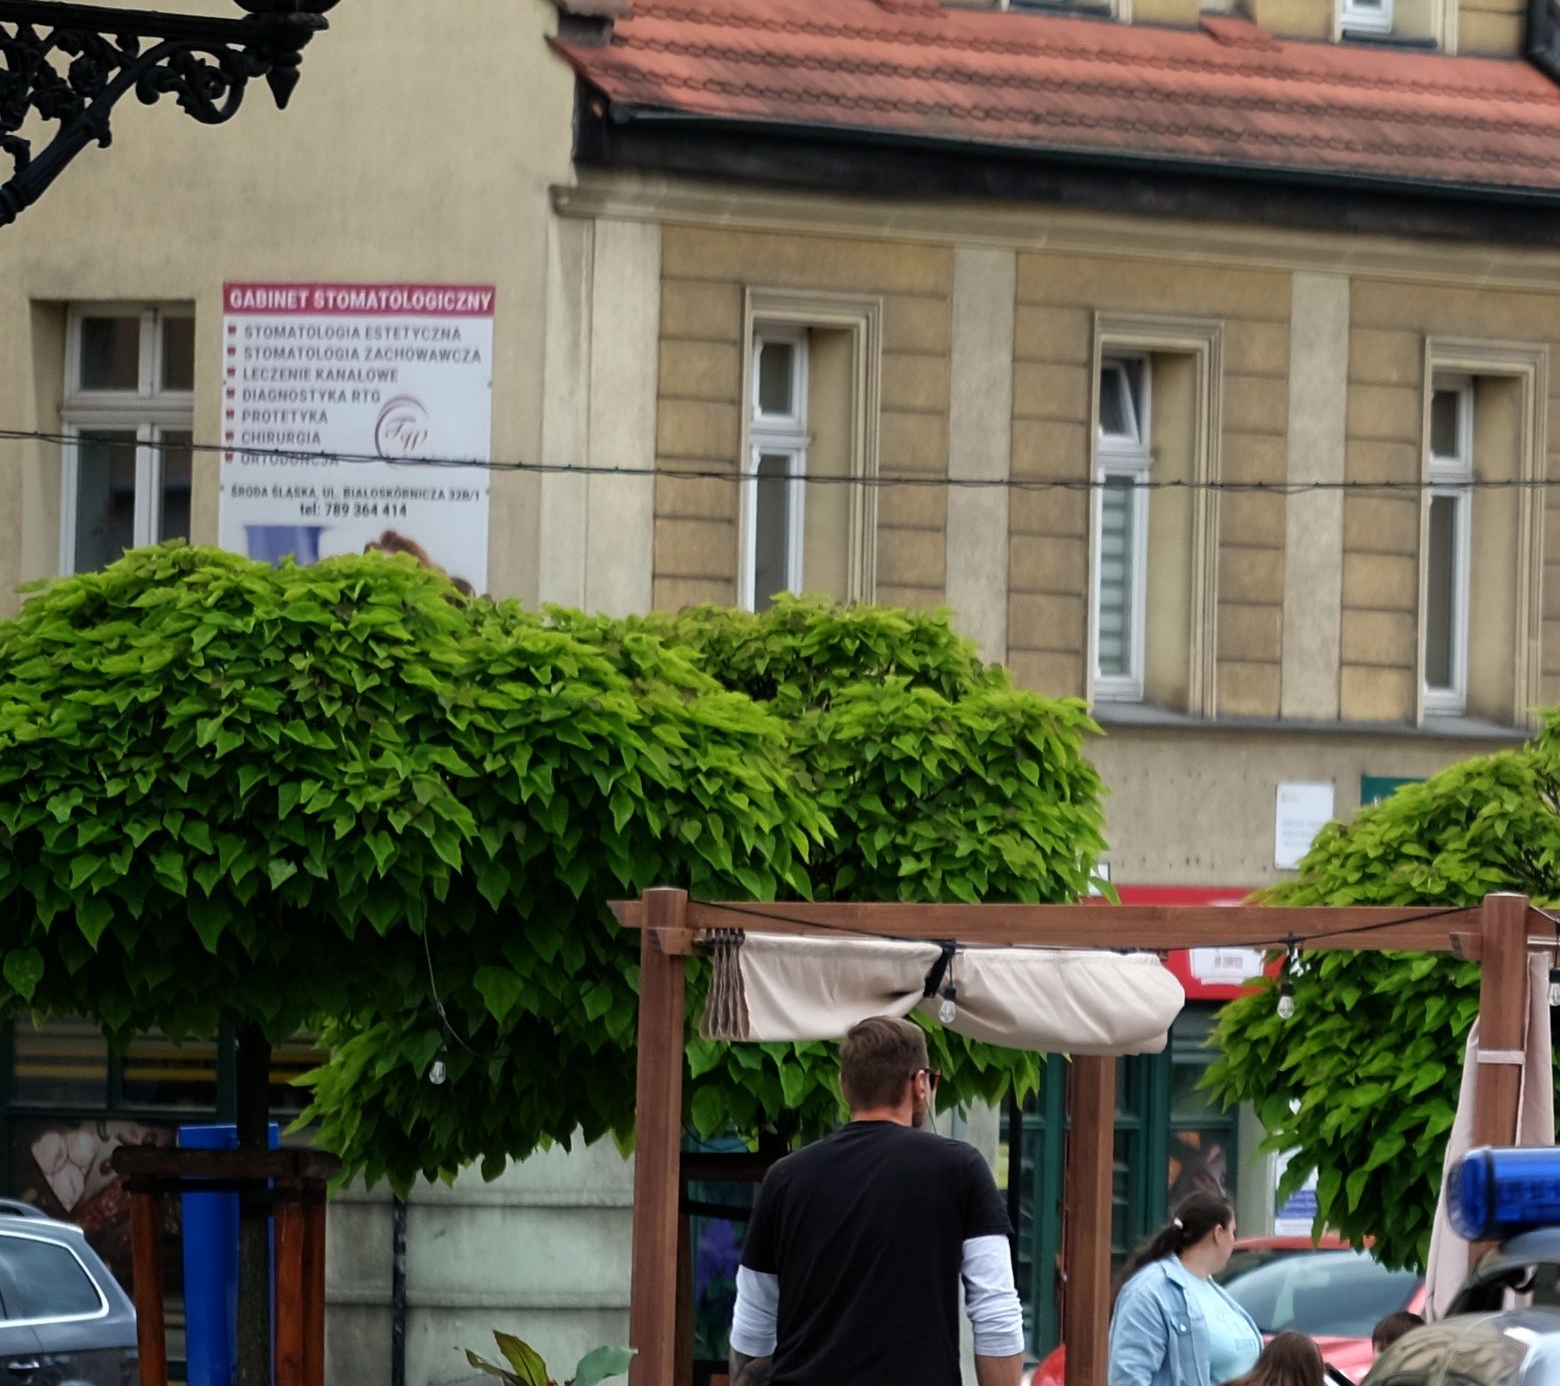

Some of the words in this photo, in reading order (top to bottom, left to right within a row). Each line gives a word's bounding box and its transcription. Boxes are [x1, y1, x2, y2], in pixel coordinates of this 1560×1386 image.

[230, 289, 309, 309] GABINET
[314, 290, 492, 311] STOMATOLOGICZNY
[244, 324, 360, 340] STOMATOLOGIA
[364, 326, 462, 342] ESTETYCZNA
[244, 346, 360, 361] STOMATOLOGIA
[364, 347, 482, 364] ZACHOWAWCZA
[243, 367, 312, 382] LECZENIE
[242, 388, 347, 403] DIAGNOSTYKA
[352, 389, 381, 404] RTG
[242, 409, 328, 424] PROTETYKA
[241, 430, 321, 444] CHIRURGIA
[325, 504, 349, 517] 789
[353, 504, 378, 517] 364
[382, 504, 407, 517] 414
